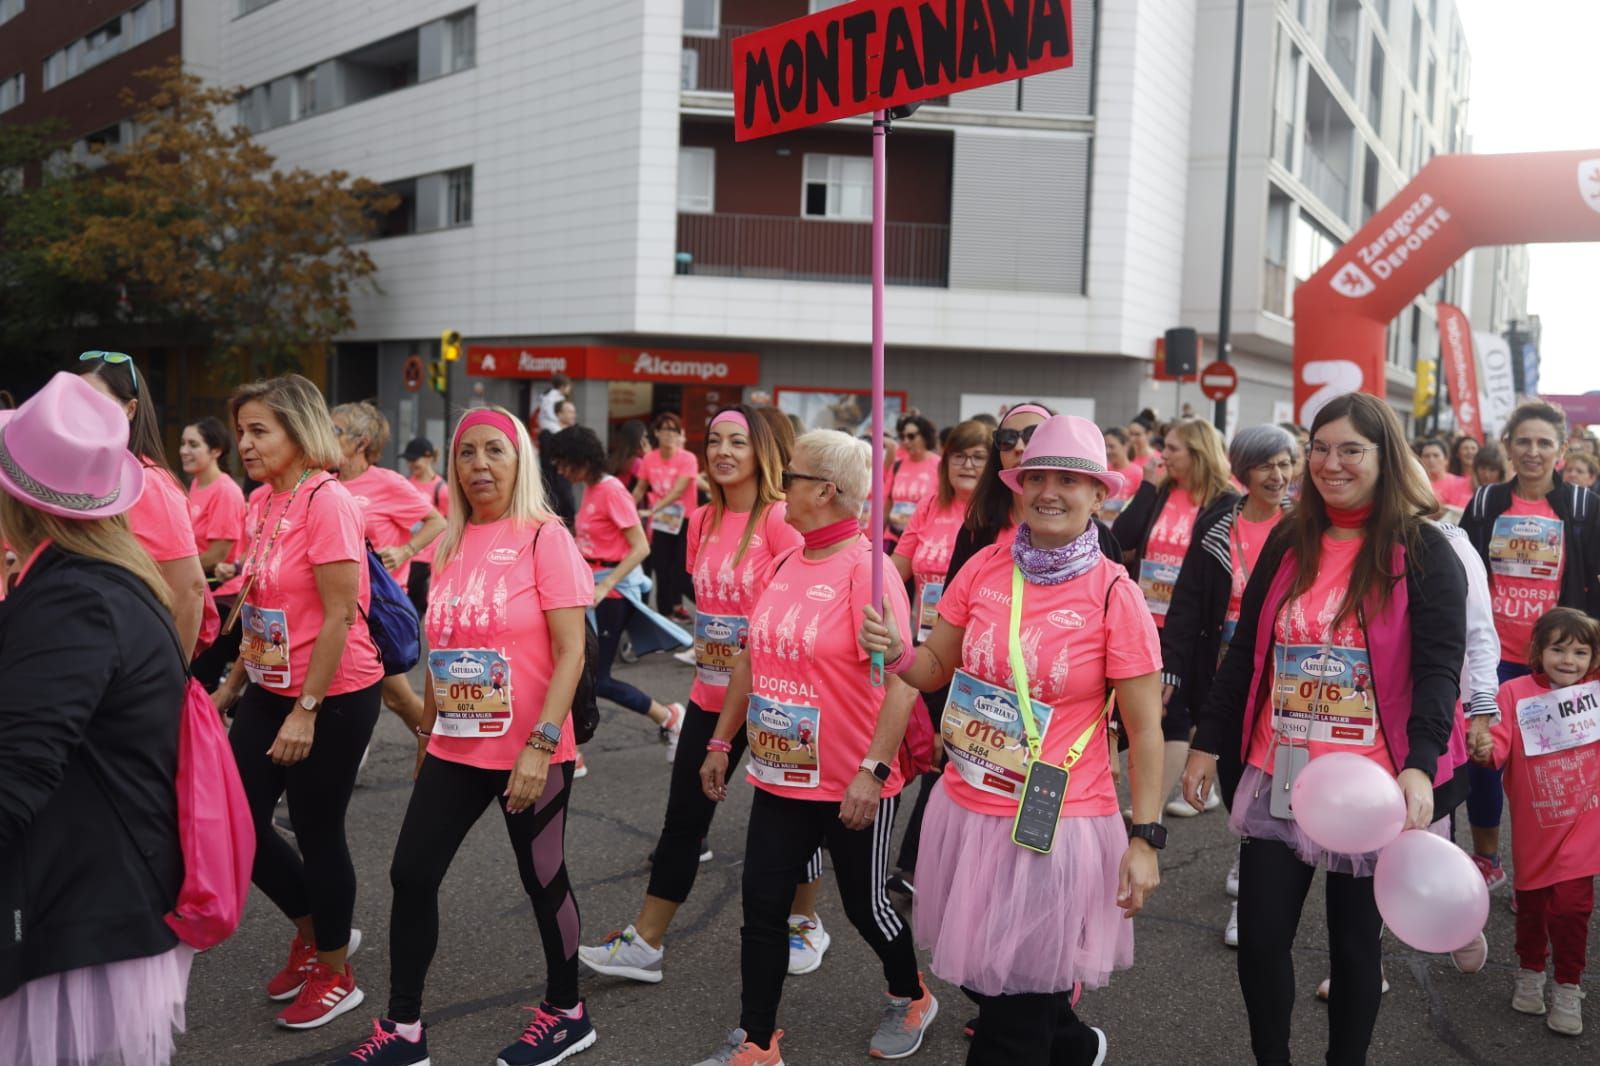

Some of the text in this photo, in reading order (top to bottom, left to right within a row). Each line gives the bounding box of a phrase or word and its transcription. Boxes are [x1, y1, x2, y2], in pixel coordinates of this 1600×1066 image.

[1357, 193, 1433, 265] Zaragoza
[1371, 207, 1450, 280] DEPORTE
[518, 351, 566, 372] Alcampo
[633, 352, 729, 379] Alcampo
[1509, 538, 1538, 551] 016
[1494, 598, 1554, 619] SUM
[705, 643, 732, 657] 016
[449, 683, 483, 700] 016
[759, 675, 819, 698] DORSAL
[457, 703, 475, 711] 6074
[974, 698, 1017, 721] ASTURIANA
[1557, 693, 1598, 719] IRATI
[965, 719, 1007, 748] 016
[1568, 718, 1597, 734] 2104
[758, 731, 789, 752] 016
